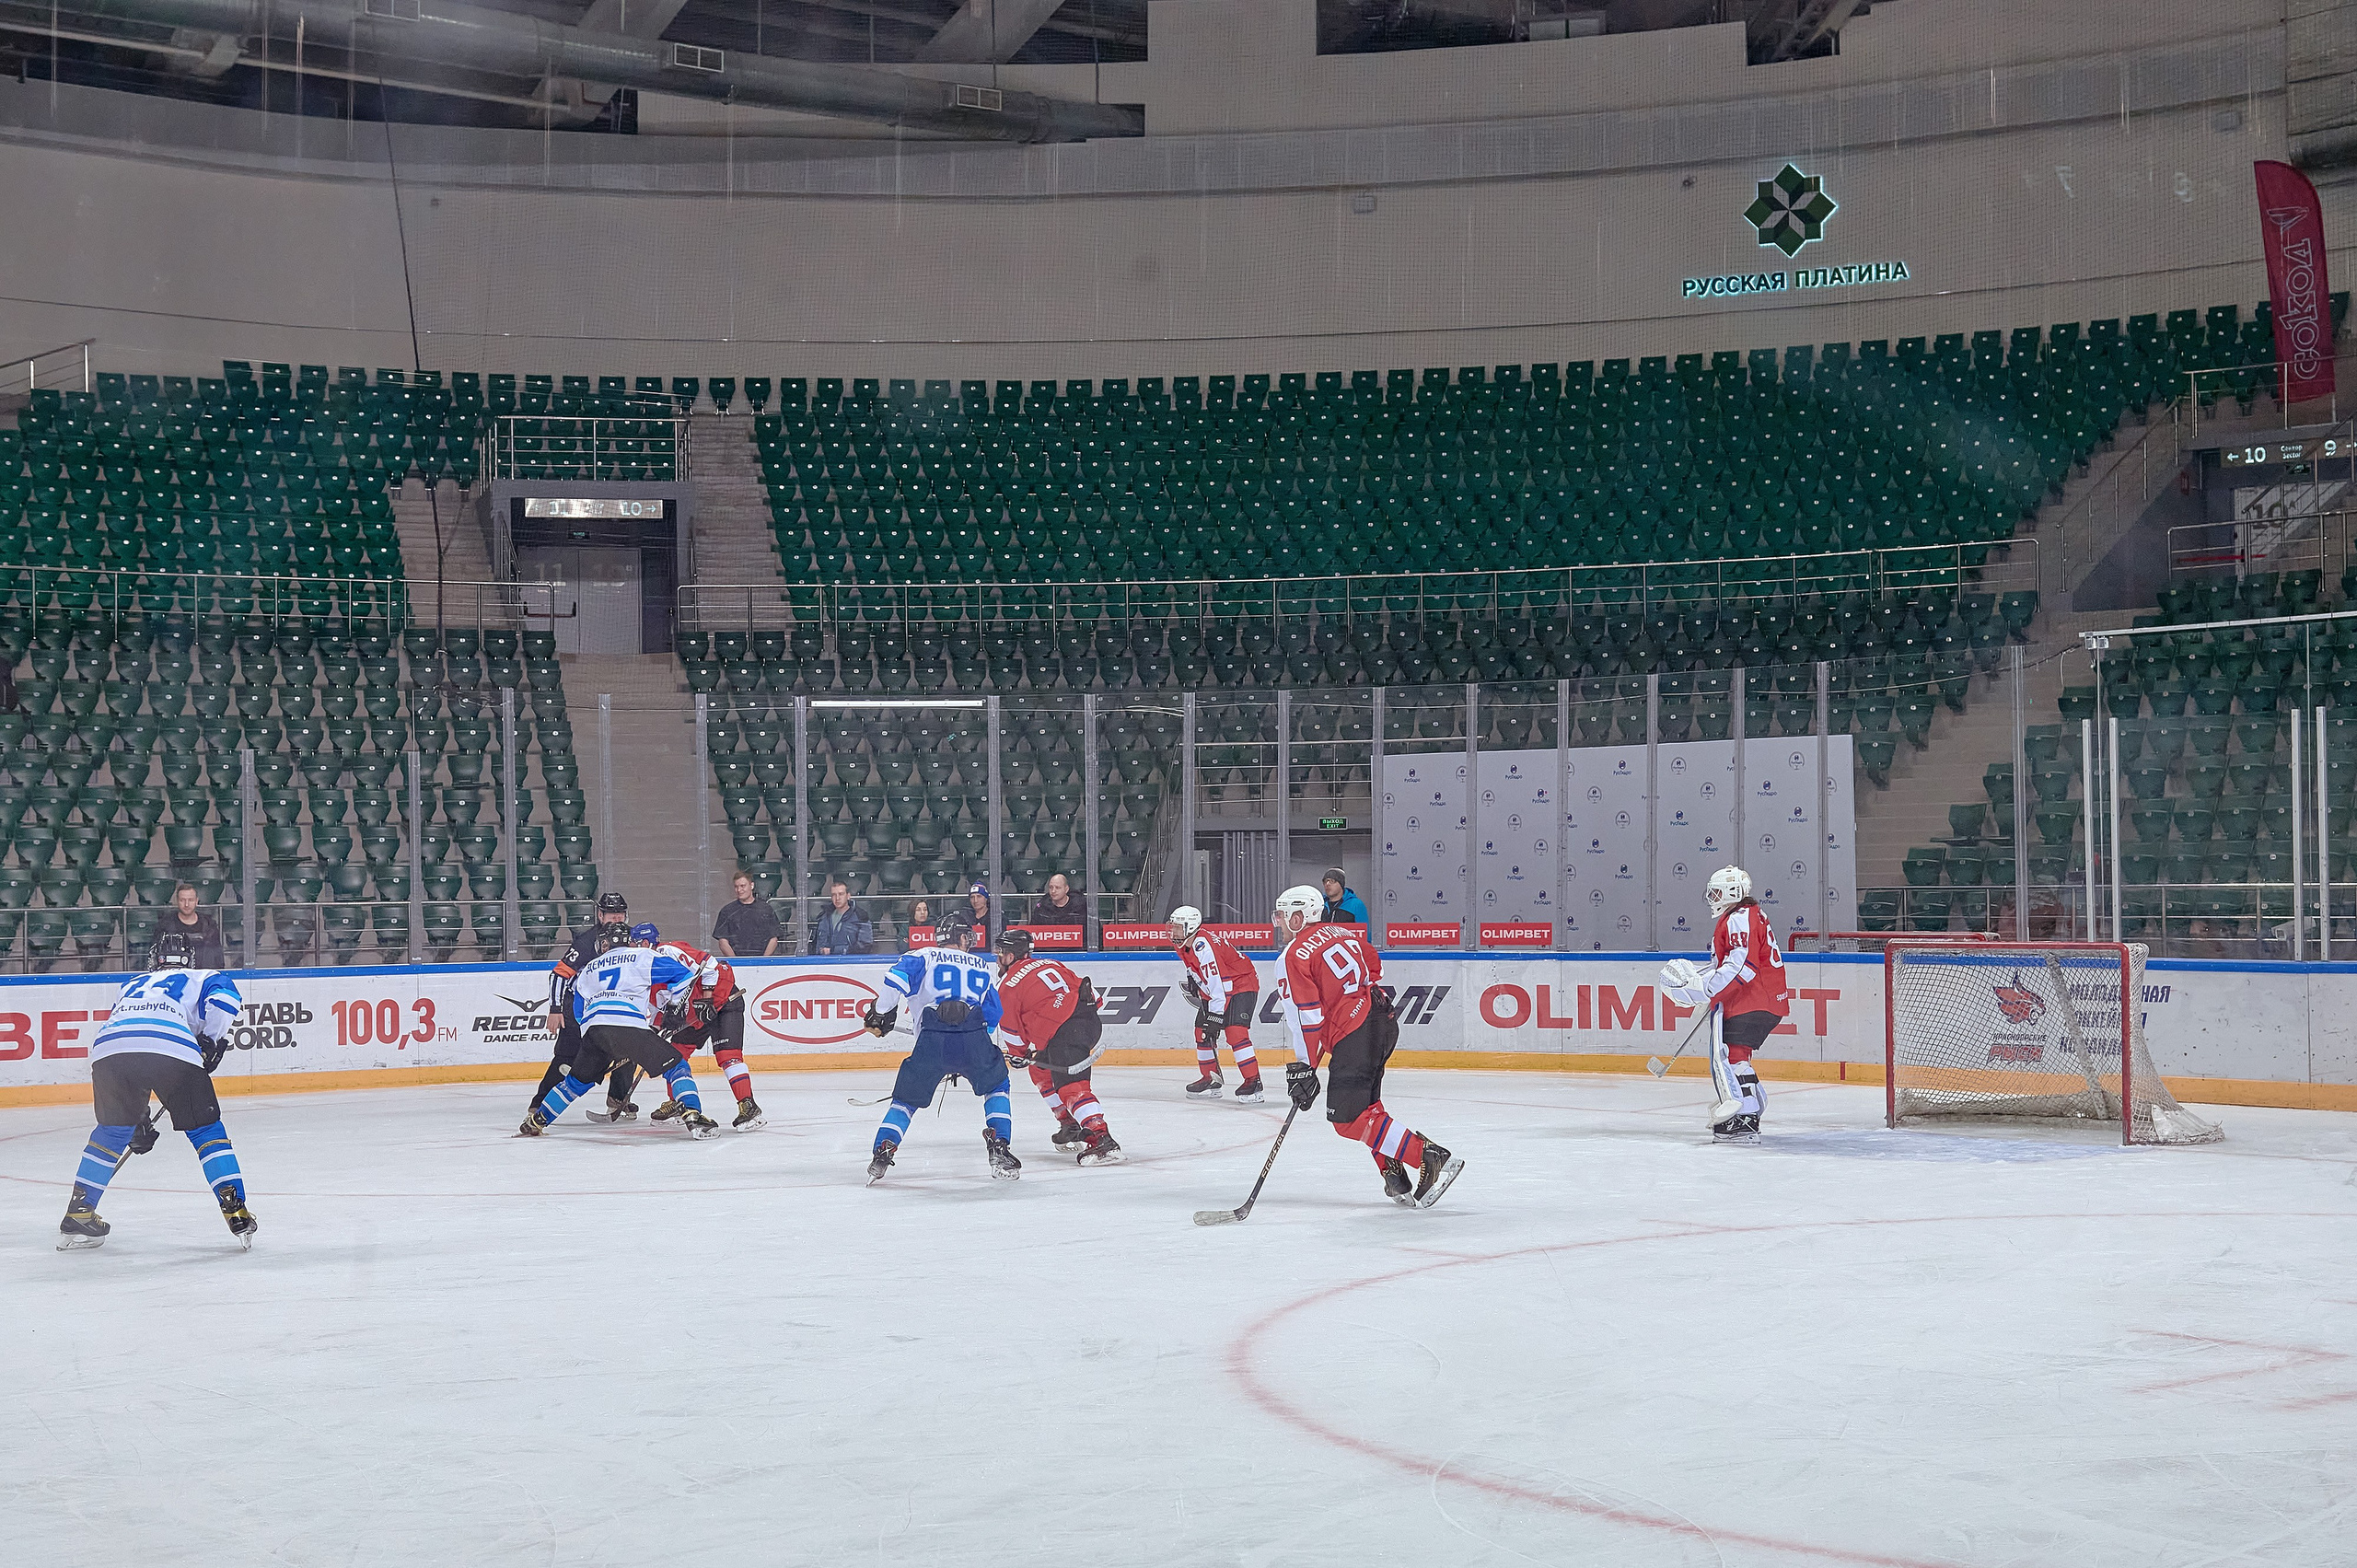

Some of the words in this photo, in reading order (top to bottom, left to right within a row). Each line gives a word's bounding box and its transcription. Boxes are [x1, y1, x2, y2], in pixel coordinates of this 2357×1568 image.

[1682, 272, 1786, 298] РУССКАЯ
[1794, 261, 1910, 288] ПЛАТИНА
[2245, 447, 2266, 463] 10
[2324, 439, 2337, 456] 9
[621, 501, 643, 517] 10
[1032, 931, 1080, 940] MPBET
[1388, 929, 1457, 938] OLIMPBET
[1482, 929, 1550, 938] OLIMPBET
[1721, 931, 1748, 948] 88
[565, 947, 579, 963] 73
[1766, 923, 1784, 969] 8
[586, 953, 637, 974] ДЕМЧЕНКО
[931, 950, 990, 970] РАМЕНСКИ
[1201, 960, 1218, 978] 75
[598, 967, 621, 990] 7
[934, 963, 991, 1006] 99
[1037, 967, 1071, 994] 9
[761, 998, 873, 1020] SINTEC
[1479, 983, 1841, 1036] OLIMPT
[331, 997, 435, 1050] 100,3
[438, 1027, 458, 1041] FM
[472, 1015, 547, 1032] RECO
[1988, 1044, 2044, 1064] РЫСИ
[1286, 1070, 1313, 1081] AUER
